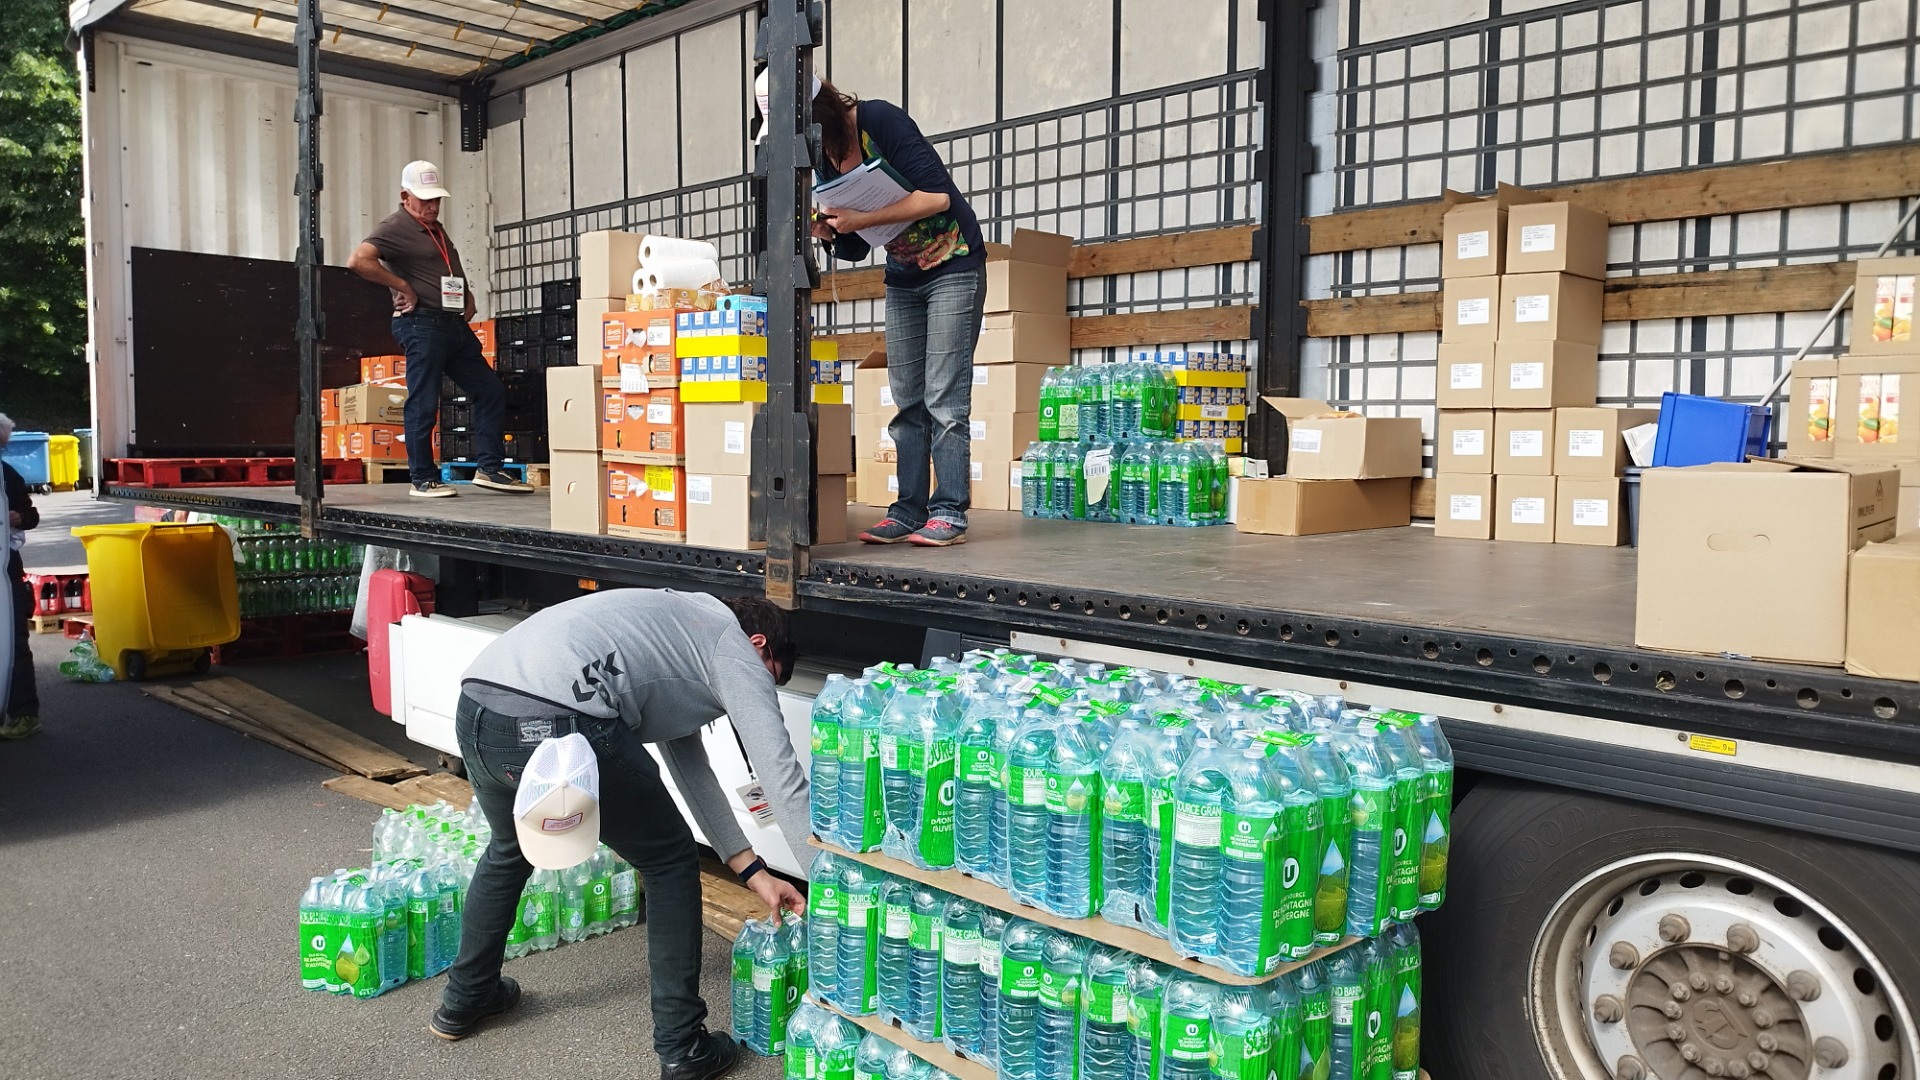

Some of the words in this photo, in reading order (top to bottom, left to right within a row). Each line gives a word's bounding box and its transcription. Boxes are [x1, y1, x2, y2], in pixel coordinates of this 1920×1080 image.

[1023, 767, 1046, 778] SOURC
[1176, 799, 1200, 816] SOURCE
[1200, 803, 1221, 816] GRAN
[1284, 864, 1295, 883] U
[848, 894, 871, 904] SOURCE
[886, 904, 909, 914] SOURCE
[931, 917, 942, 926] SOU
[945, 926, 963, 939] OURCE
[963, 929, 981, 940] GRAN
[1112, 985, 1127, 995] SOU
[829, 1049, 855, 1070] SOU
